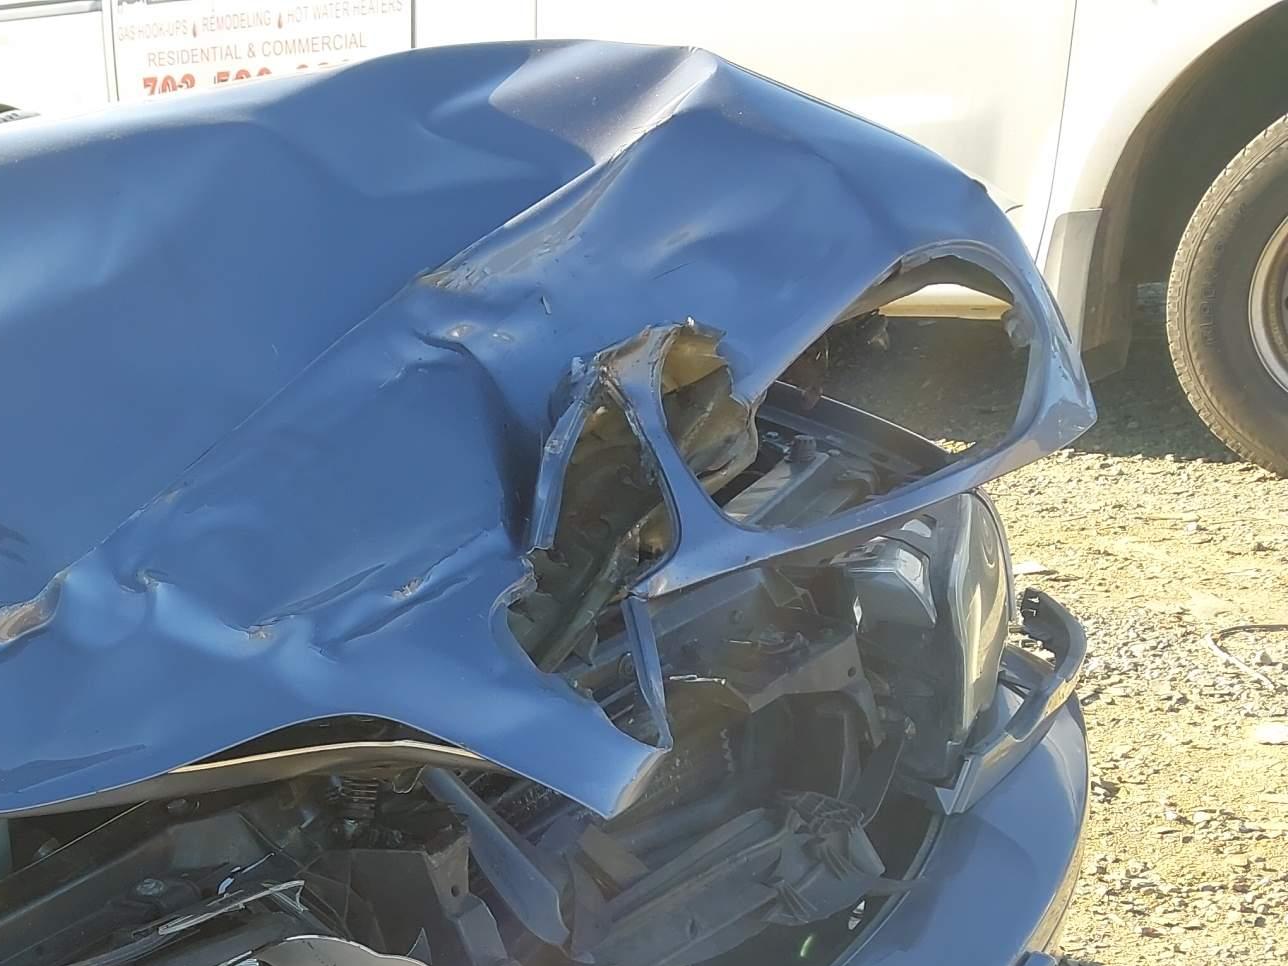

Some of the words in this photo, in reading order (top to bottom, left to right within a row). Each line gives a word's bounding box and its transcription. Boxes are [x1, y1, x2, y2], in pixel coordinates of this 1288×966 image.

[202, 9, 272, 33] REMODELING
[287, 6, 309, 23] HOT
[312, 1, 350, 20] WATER
[352, 0, 404, 15] HEATERS
[147, 43, 242, 67] RESIDENTIAL
[247, 41, 256, 58] &
[261, 34, 368, 56] COMMERCIAL
